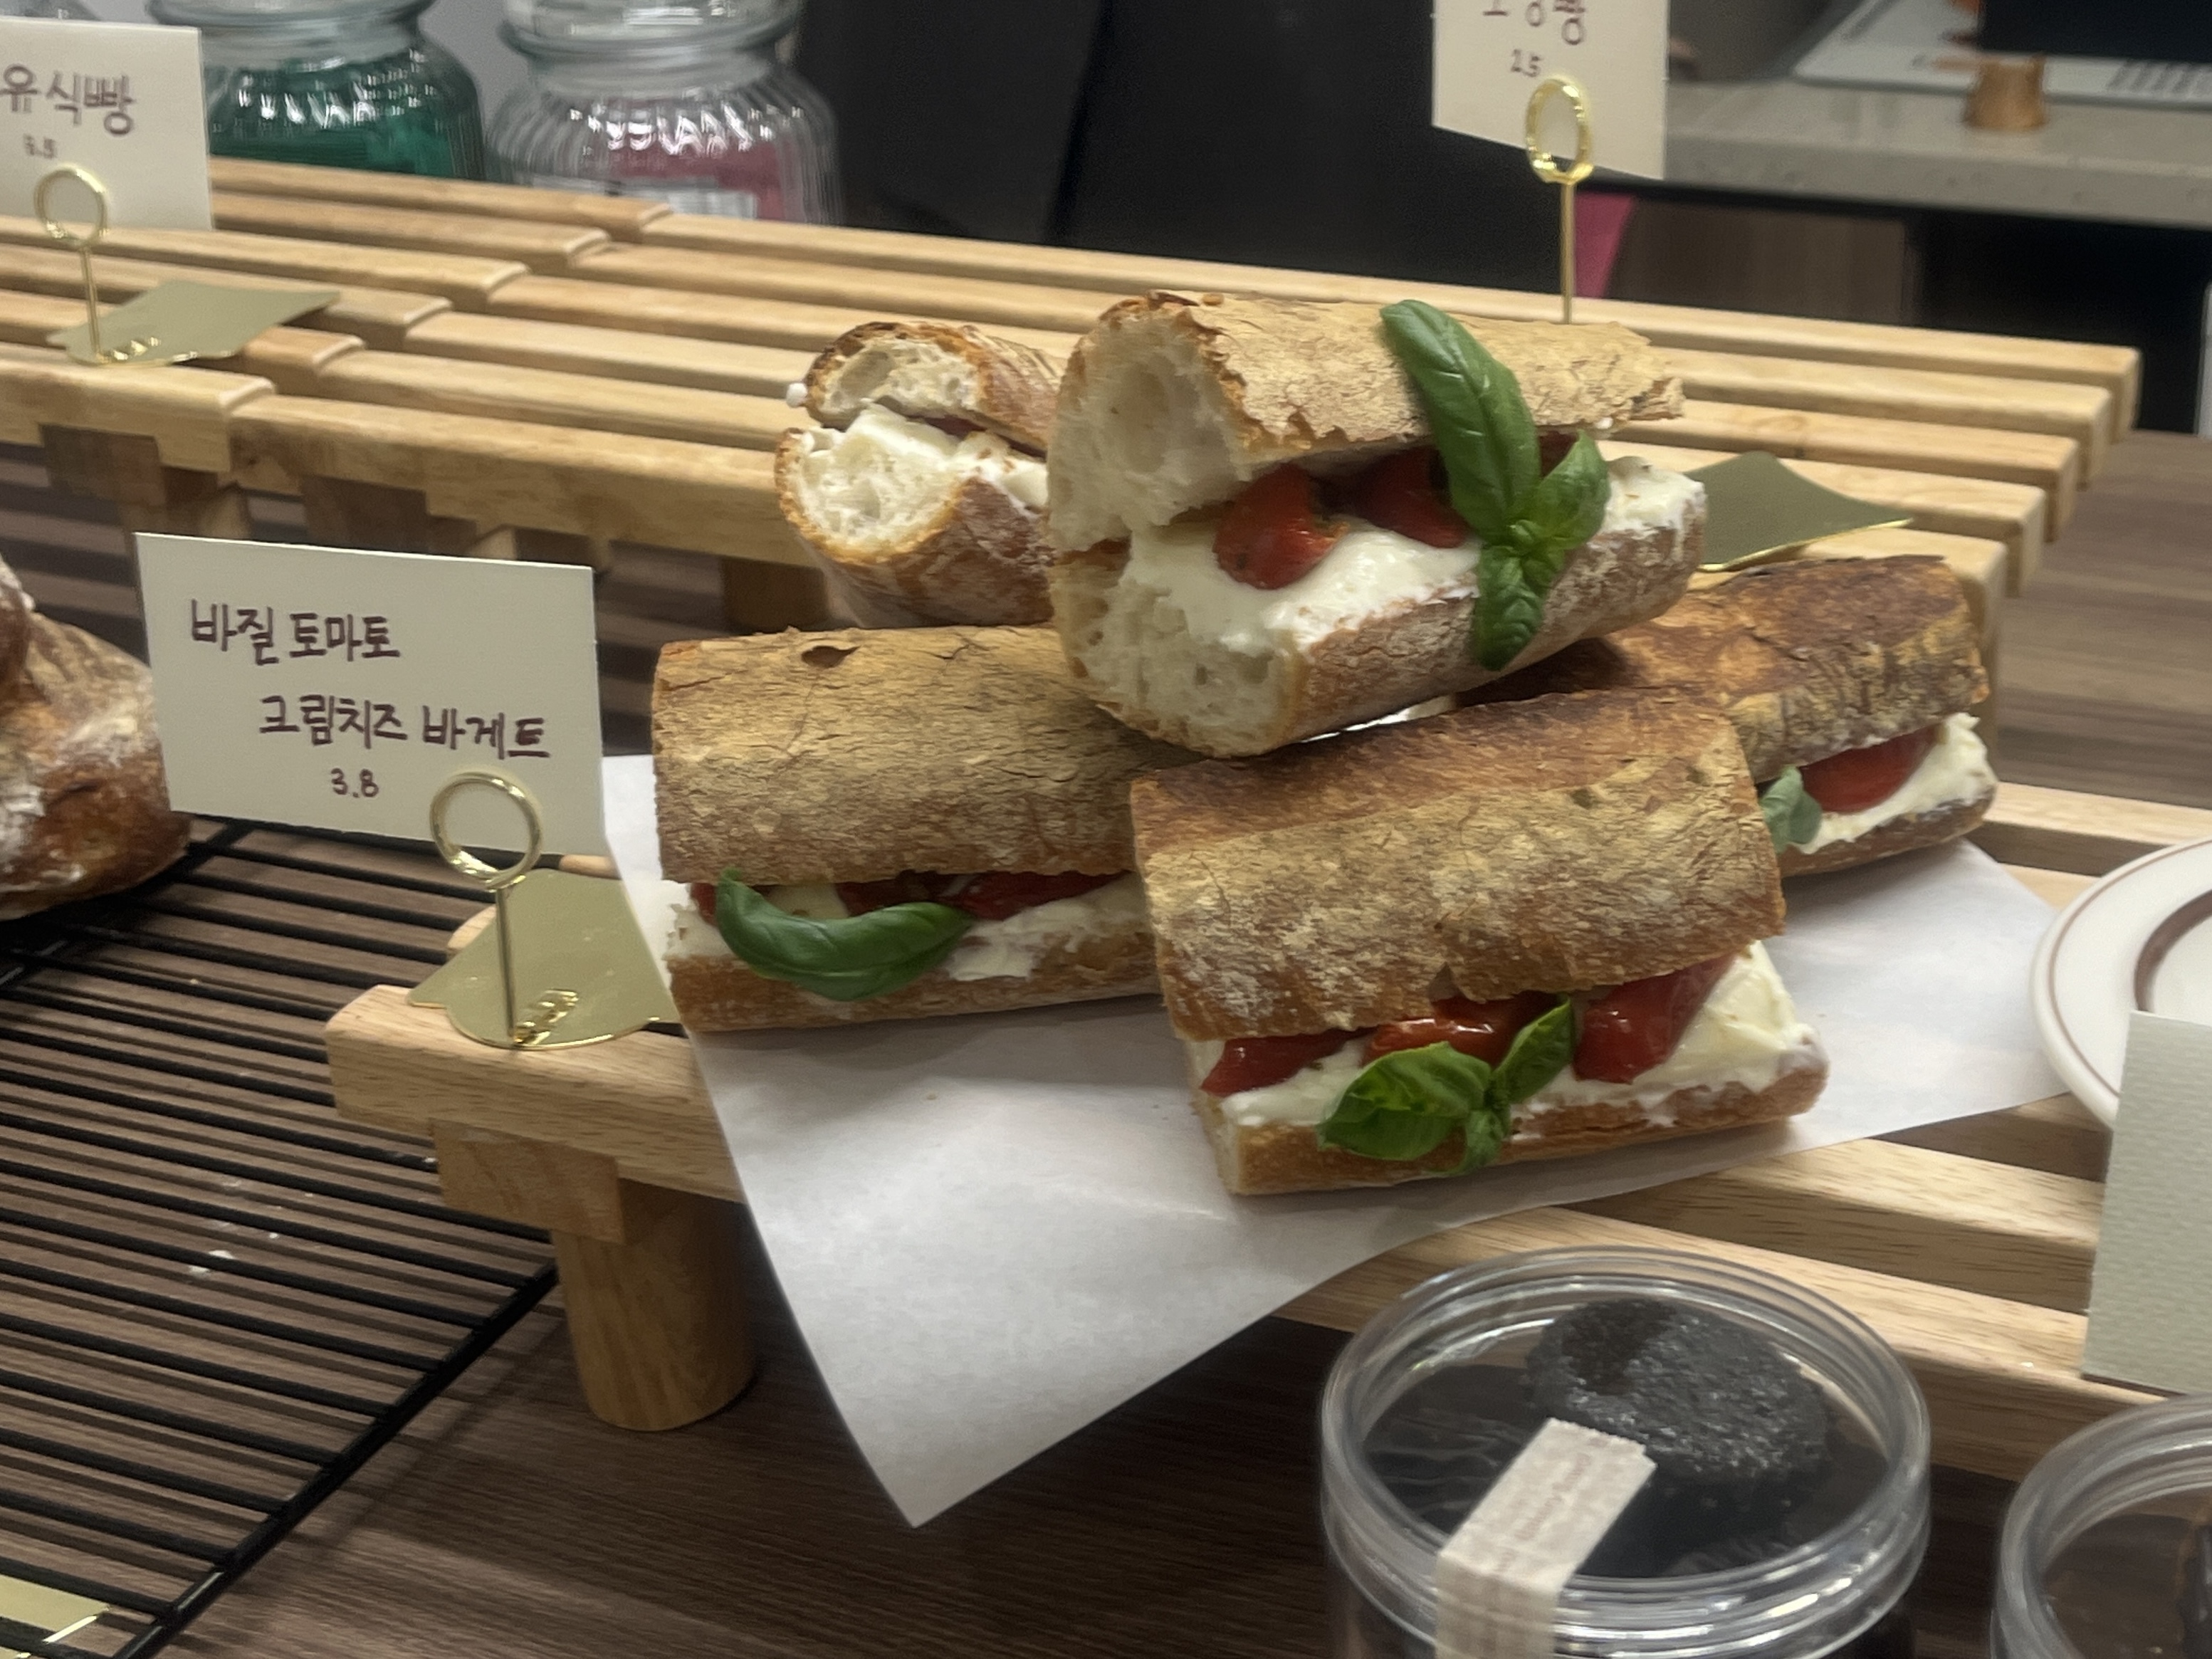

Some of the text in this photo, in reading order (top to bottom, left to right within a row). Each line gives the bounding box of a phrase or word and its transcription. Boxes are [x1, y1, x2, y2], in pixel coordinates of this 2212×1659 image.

[191, 598, 401, 666] 바질 토마토
[258, 694, 551, 760] 크림치즈 바게트
[330, 768, 380, 798] 3.8
